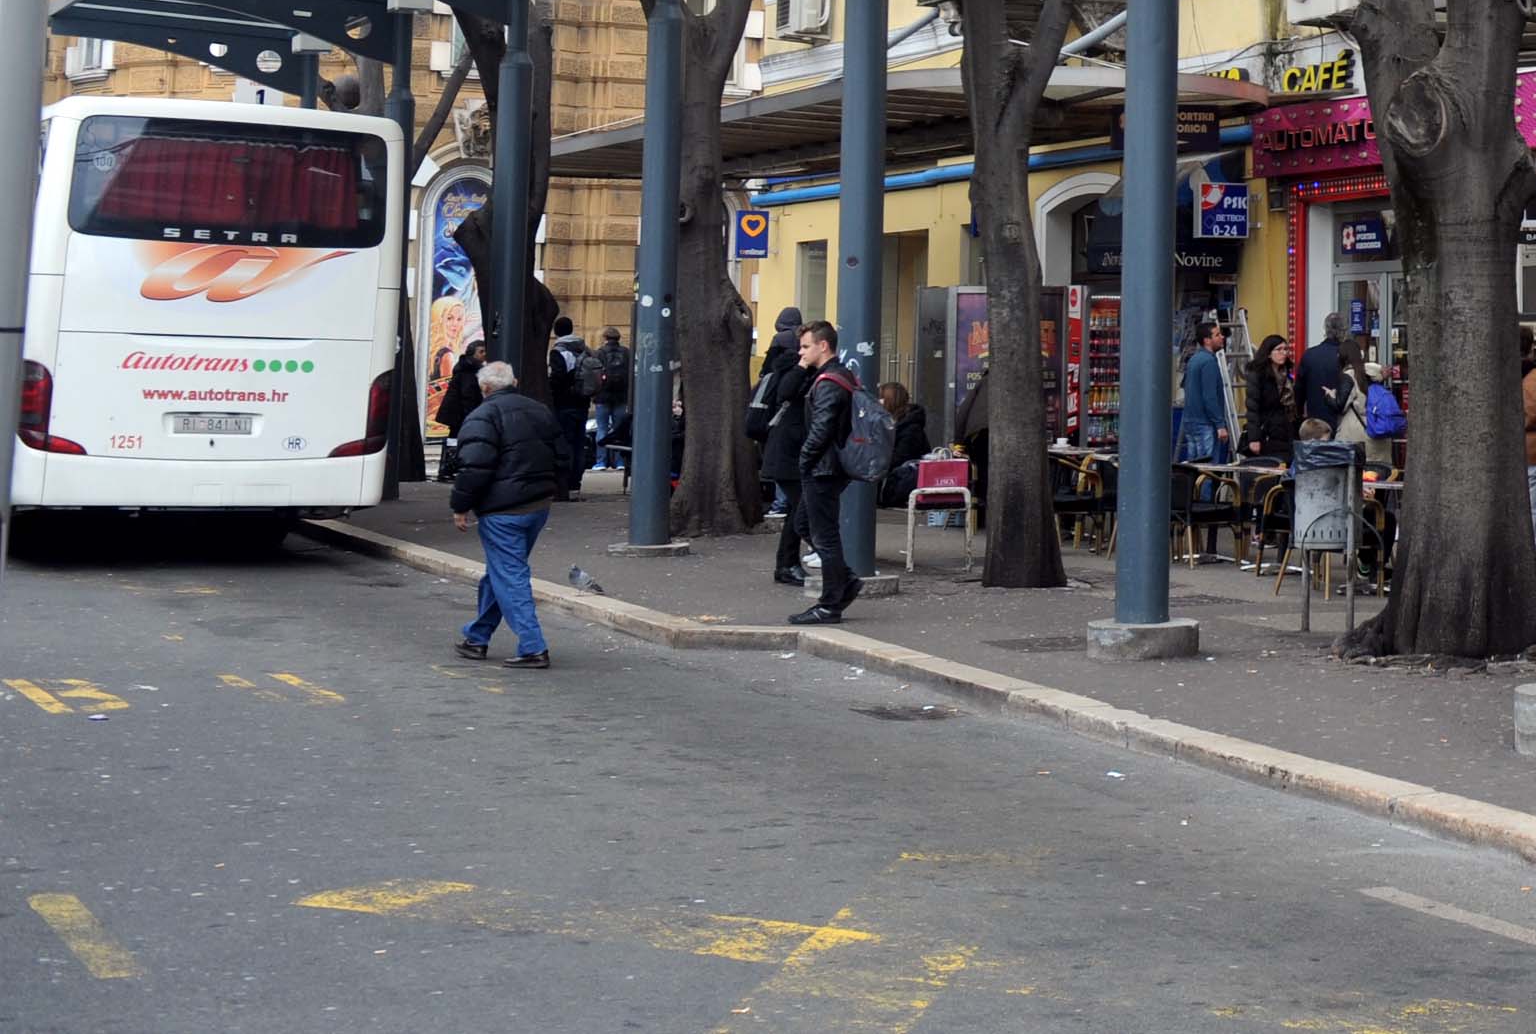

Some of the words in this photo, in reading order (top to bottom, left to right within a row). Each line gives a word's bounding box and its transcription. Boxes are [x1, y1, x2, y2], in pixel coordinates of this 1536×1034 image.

[1215, 214, 1245, 222] BETBOX
[163, 227, 298, 244] SETRA
[1212, 225, 1237, 237] 0-24
[1174, 252, 1223, 267] Novine
[142, 388, 289, 403] www.autotrans.hr
[110, 435, 143, 449] 1251
[287, 437, 302, 448] HR
